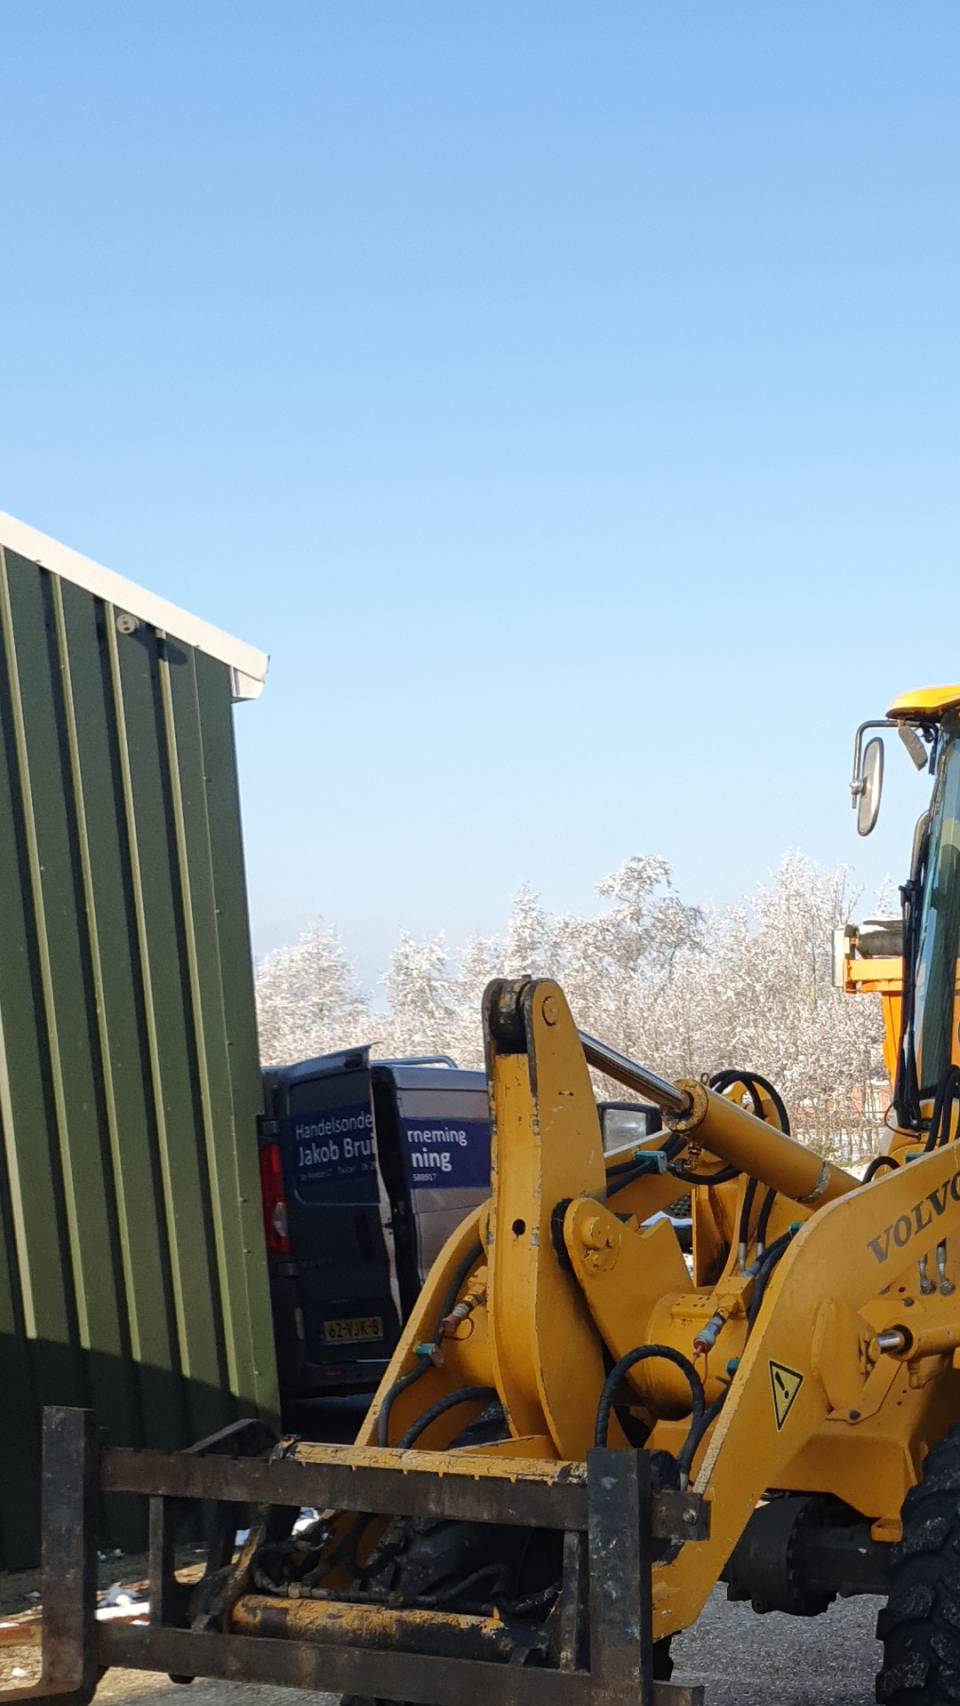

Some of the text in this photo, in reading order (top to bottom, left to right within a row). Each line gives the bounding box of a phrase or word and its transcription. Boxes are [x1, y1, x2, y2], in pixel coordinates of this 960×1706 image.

[407, 1127, 468, 1146] rneming
[299, 1140, 340, 1167] Jakob
[411, 1147, 452, 1172] ning
